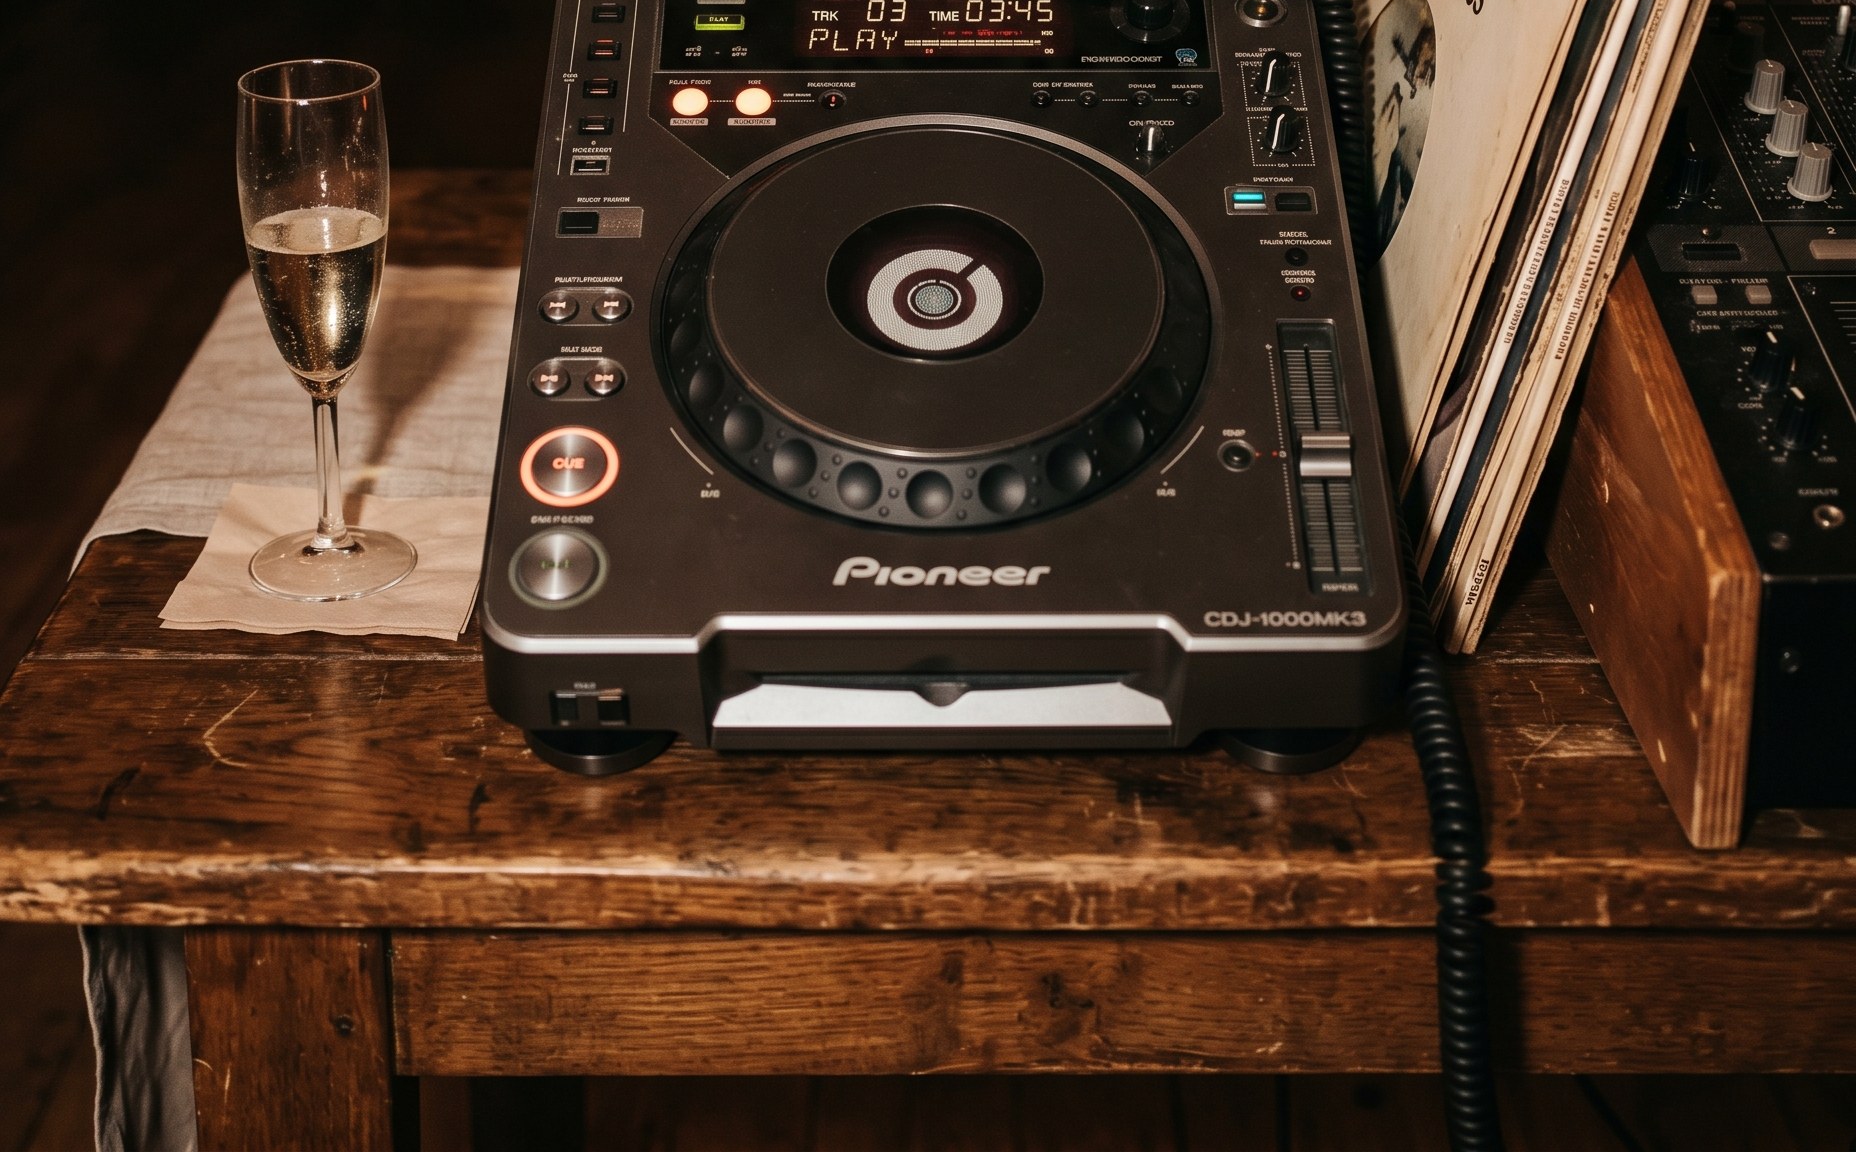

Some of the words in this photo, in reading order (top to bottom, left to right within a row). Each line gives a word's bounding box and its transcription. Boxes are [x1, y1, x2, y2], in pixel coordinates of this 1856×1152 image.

[811, 10, 839, 22] TRK
[866, 0, 907, 22] 03
[928, 10, 960, 22] TIME
[965, 0, 1053, 23] 03:45
[808, 28, 898, 52] PLAY
[552, 457, 585, 470] CUE
[832, 556, 1051, 587] Pioneer
[1203, 610, 1367, 628] CDJ-1000MK3
